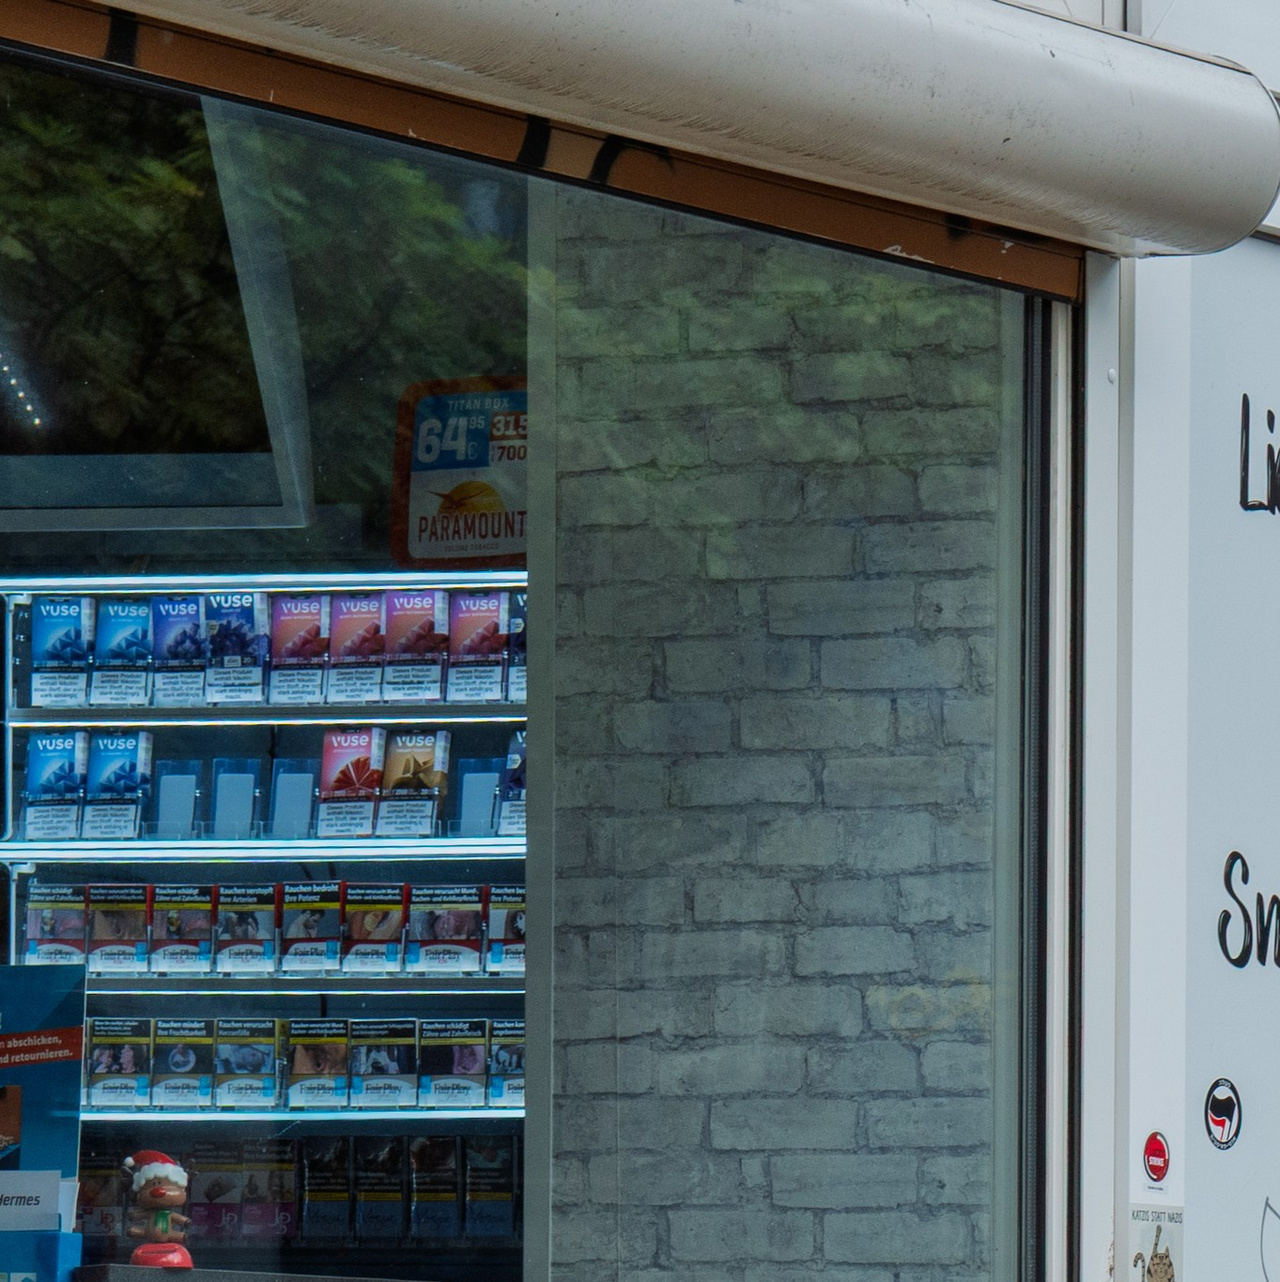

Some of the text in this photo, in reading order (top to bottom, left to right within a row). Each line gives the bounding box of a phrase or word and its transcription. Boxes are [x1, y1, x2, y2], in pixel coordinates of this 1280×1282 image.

[416, 417, 468, 464] 64
[418, 510, 527, 543] PARAMOUNT
[0, 1193, 40, 1207] ermes
[1131, 1210, 1183, 1224] KATZIS STATT NAZIS
